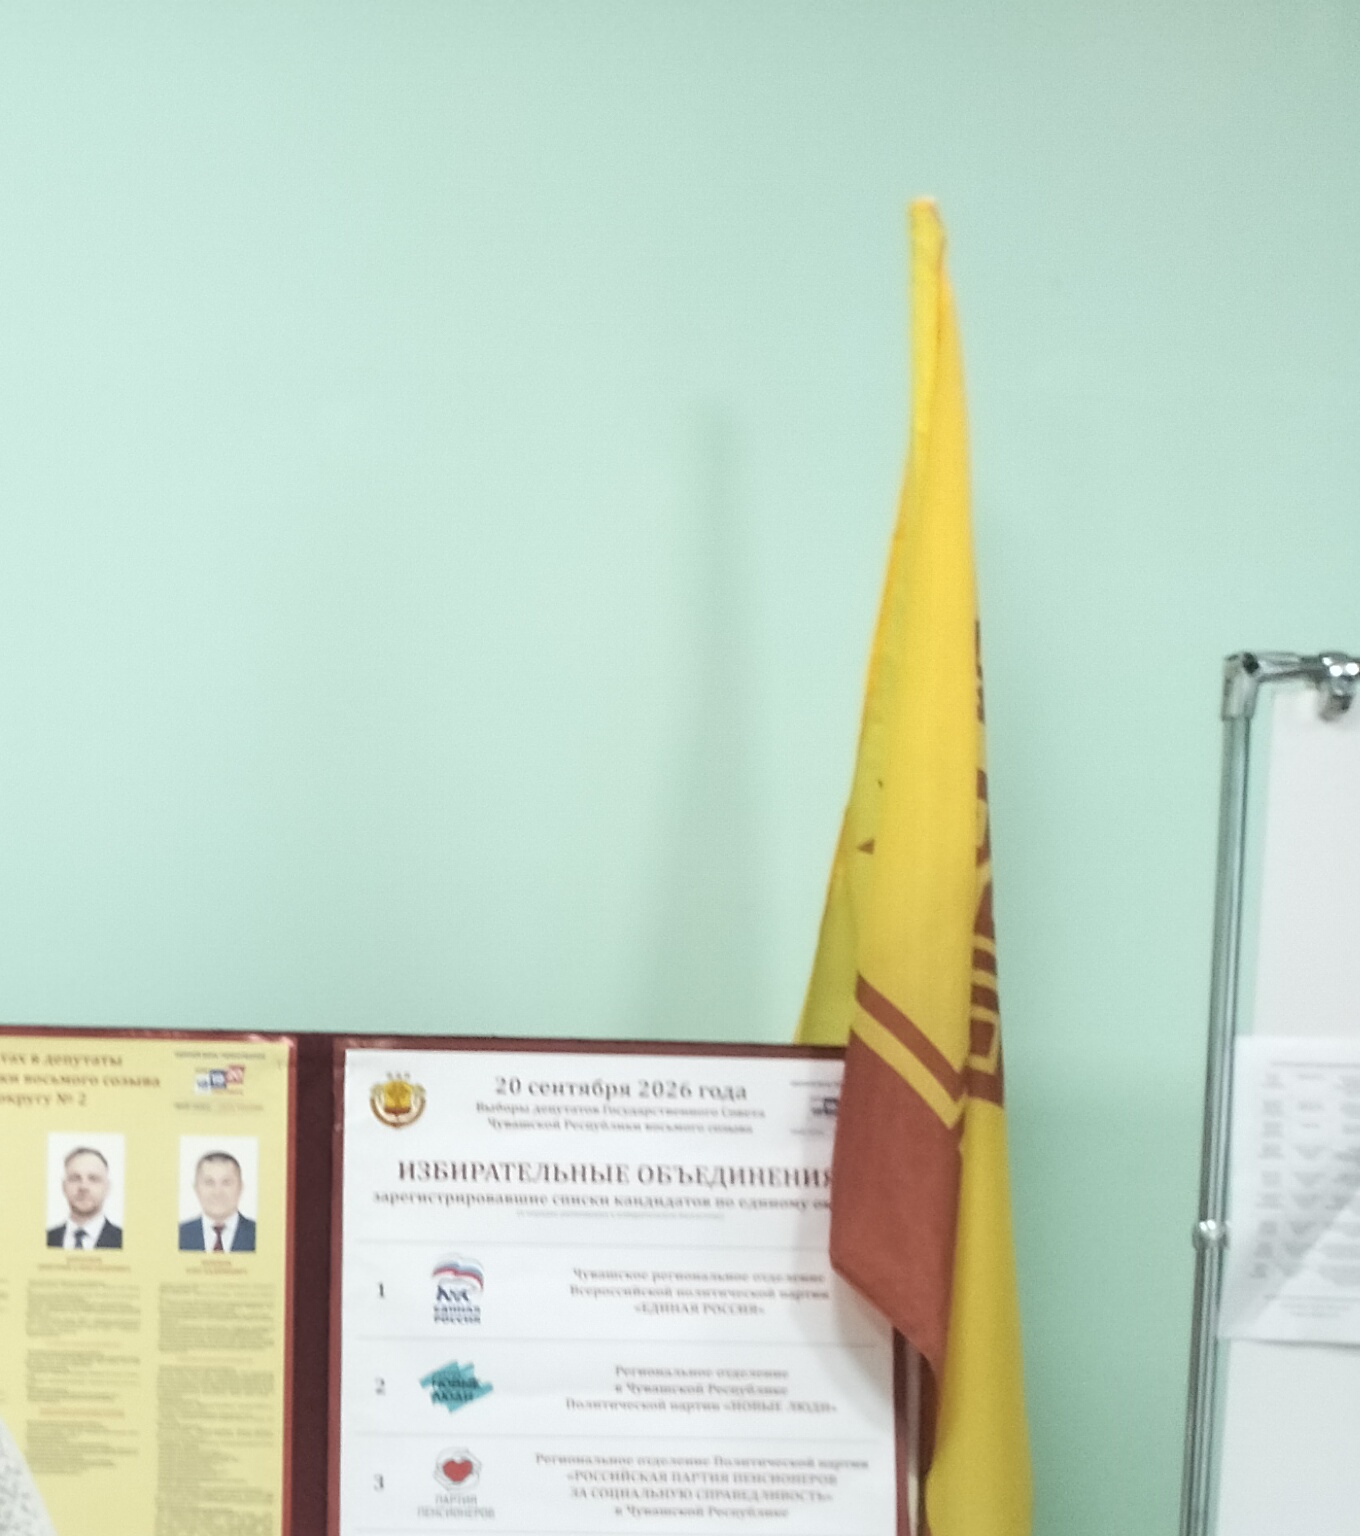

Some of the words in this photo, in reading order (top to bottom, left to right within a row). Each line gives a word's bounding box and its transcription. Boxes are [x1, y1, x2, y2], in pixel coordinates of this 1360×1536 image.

[495, 1077, 521, 1094] 20
[528, 1081, 630, 1096] сентября
[638, 1080, 692, 1098] 2026
[698, 1085, 746, 1100] года
[78, 1092, 88, 1106] 2
[398, 1160, 628, 1183] ИЗБИРАТЕЛЬНЫЕ
[378, 1282, 385, 1298] 1
[375, 1377, 386, 1395] 2
[373, 1473, 385, 1491] 3
[435, 1494, 478, 1505] ПАРТИЯ
[417, 1506, 496, 1519] ПЕНСИОНЕРОВ
